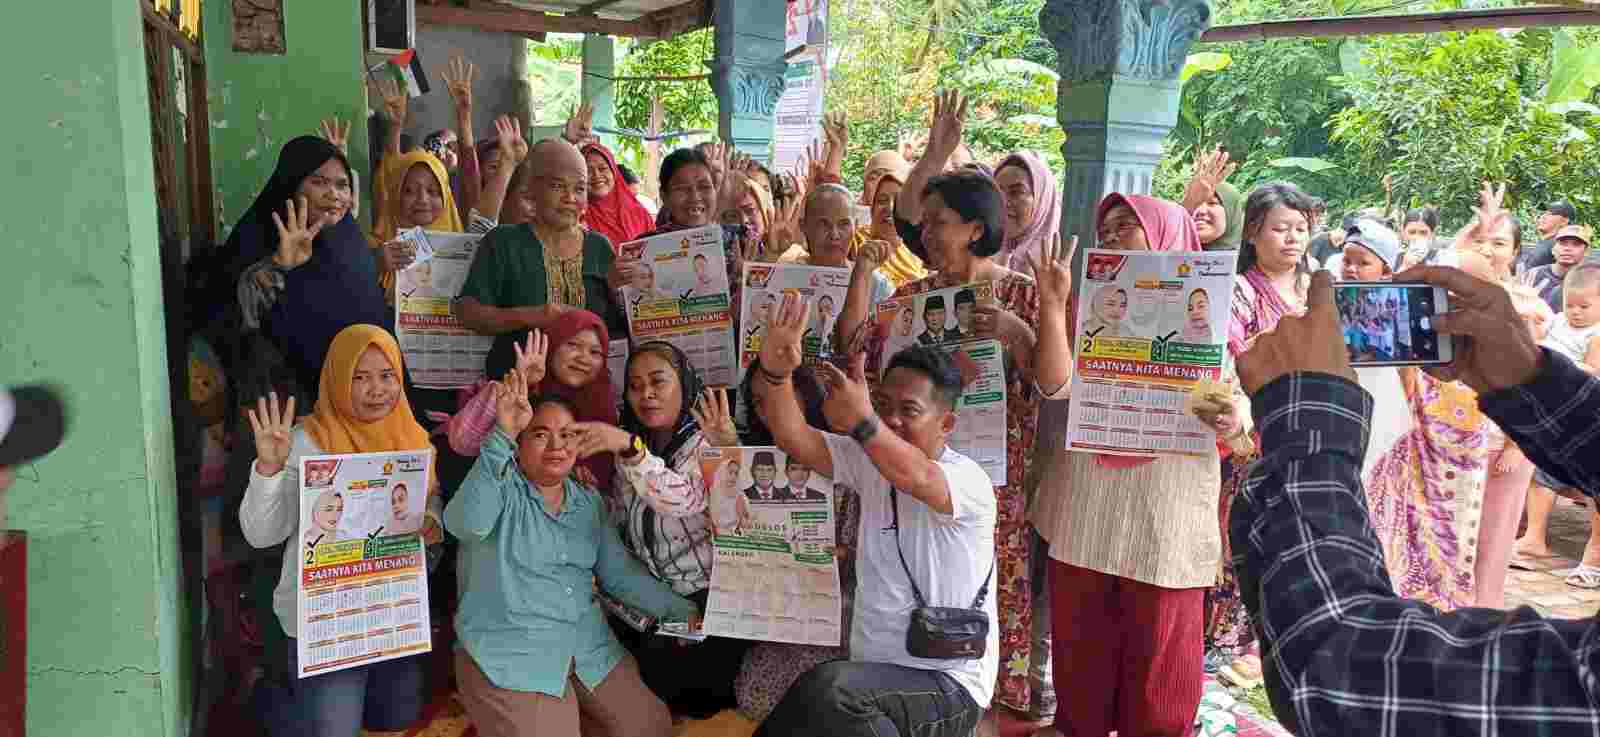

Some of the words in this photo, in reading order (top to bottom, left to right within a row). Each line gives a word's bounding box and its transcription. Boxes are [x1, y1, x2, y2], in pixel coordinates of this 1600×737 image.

[1082, 339, 1093, 353] 2
[1086, 360, 1133, 373] SAATNYA
[1136, 363, 1160, 376] KITA
[1163, 366, 1213, 380] MENANG
[305, 549, 314, 564] 2
[309, 566, 350, 580] SAATNYA
[351, 561, 373, 576] KITA
[376, 556, 416, 569] MENANG
